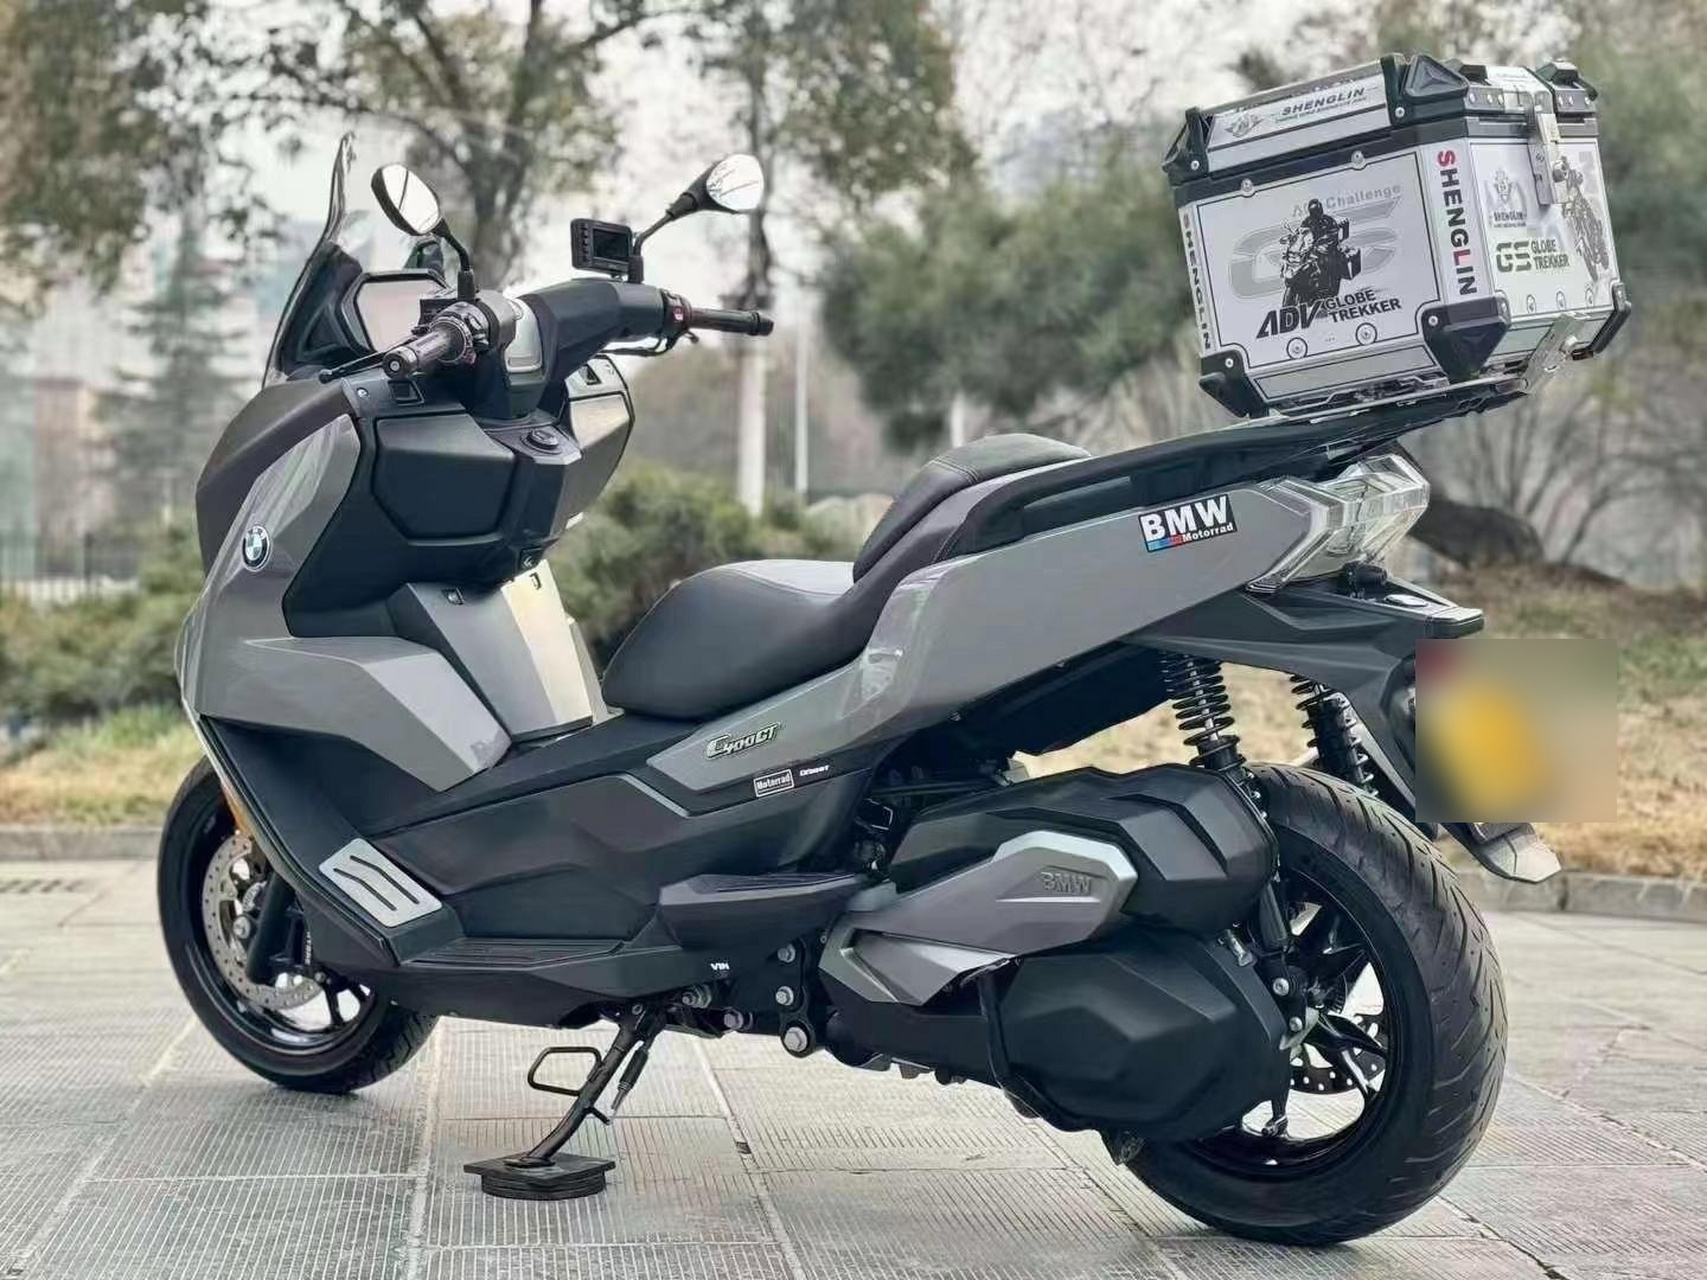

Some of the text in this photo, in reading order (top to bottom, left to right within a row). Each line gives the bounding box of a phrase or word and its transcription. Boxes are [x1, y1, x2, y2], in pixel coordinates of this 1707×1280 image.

[1281, 86, 1366, 117] SHENGLIN
[1325, 184, 1402, 210] Challenge
[1438, 149, 1478, 297] SHENGLIN
[1496, 240, 1533, 273] GS
[1530, 238, 1558, 255] GLOBE
[1533, 253, 1571, 271] TREKKER
[1326, 289, 1377, 311] GLOBE
[1329, 297, 1403, 324] TREKKER
[1255, 299, 1326, 340] ADV
[1140, 496, 1227, 542] BMW
[1182, 522, 1234, 542] Motorrad
[1040, 872, 1092, 895] BMW
